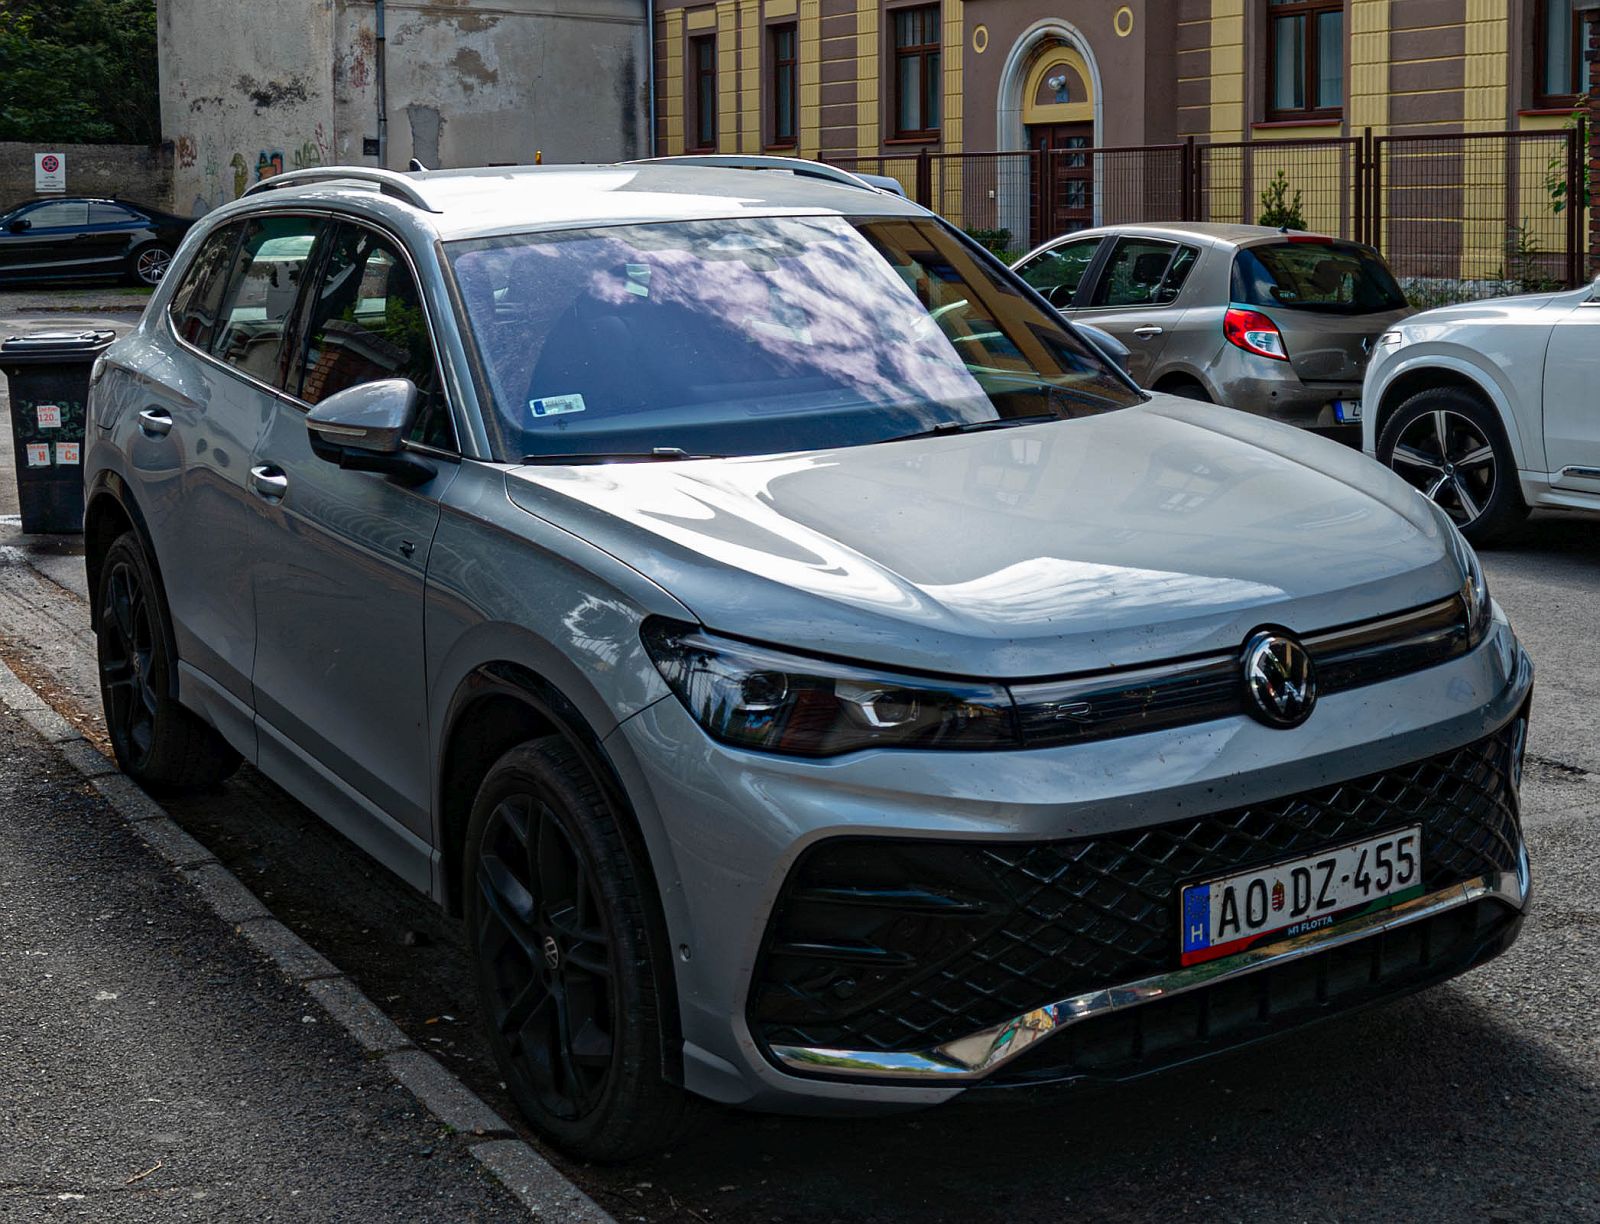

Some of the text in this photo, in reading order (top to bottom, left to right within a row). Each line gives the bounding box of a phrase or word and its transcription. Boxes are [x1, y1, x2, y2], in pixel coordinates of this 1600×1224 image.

[39, 414, 54, 422] 120
[1218, 835, 1415, 938] AO DZ-455
[1190, 922, 1203, 944] H
[1300, 915, 1334, 932] FLOTTA
